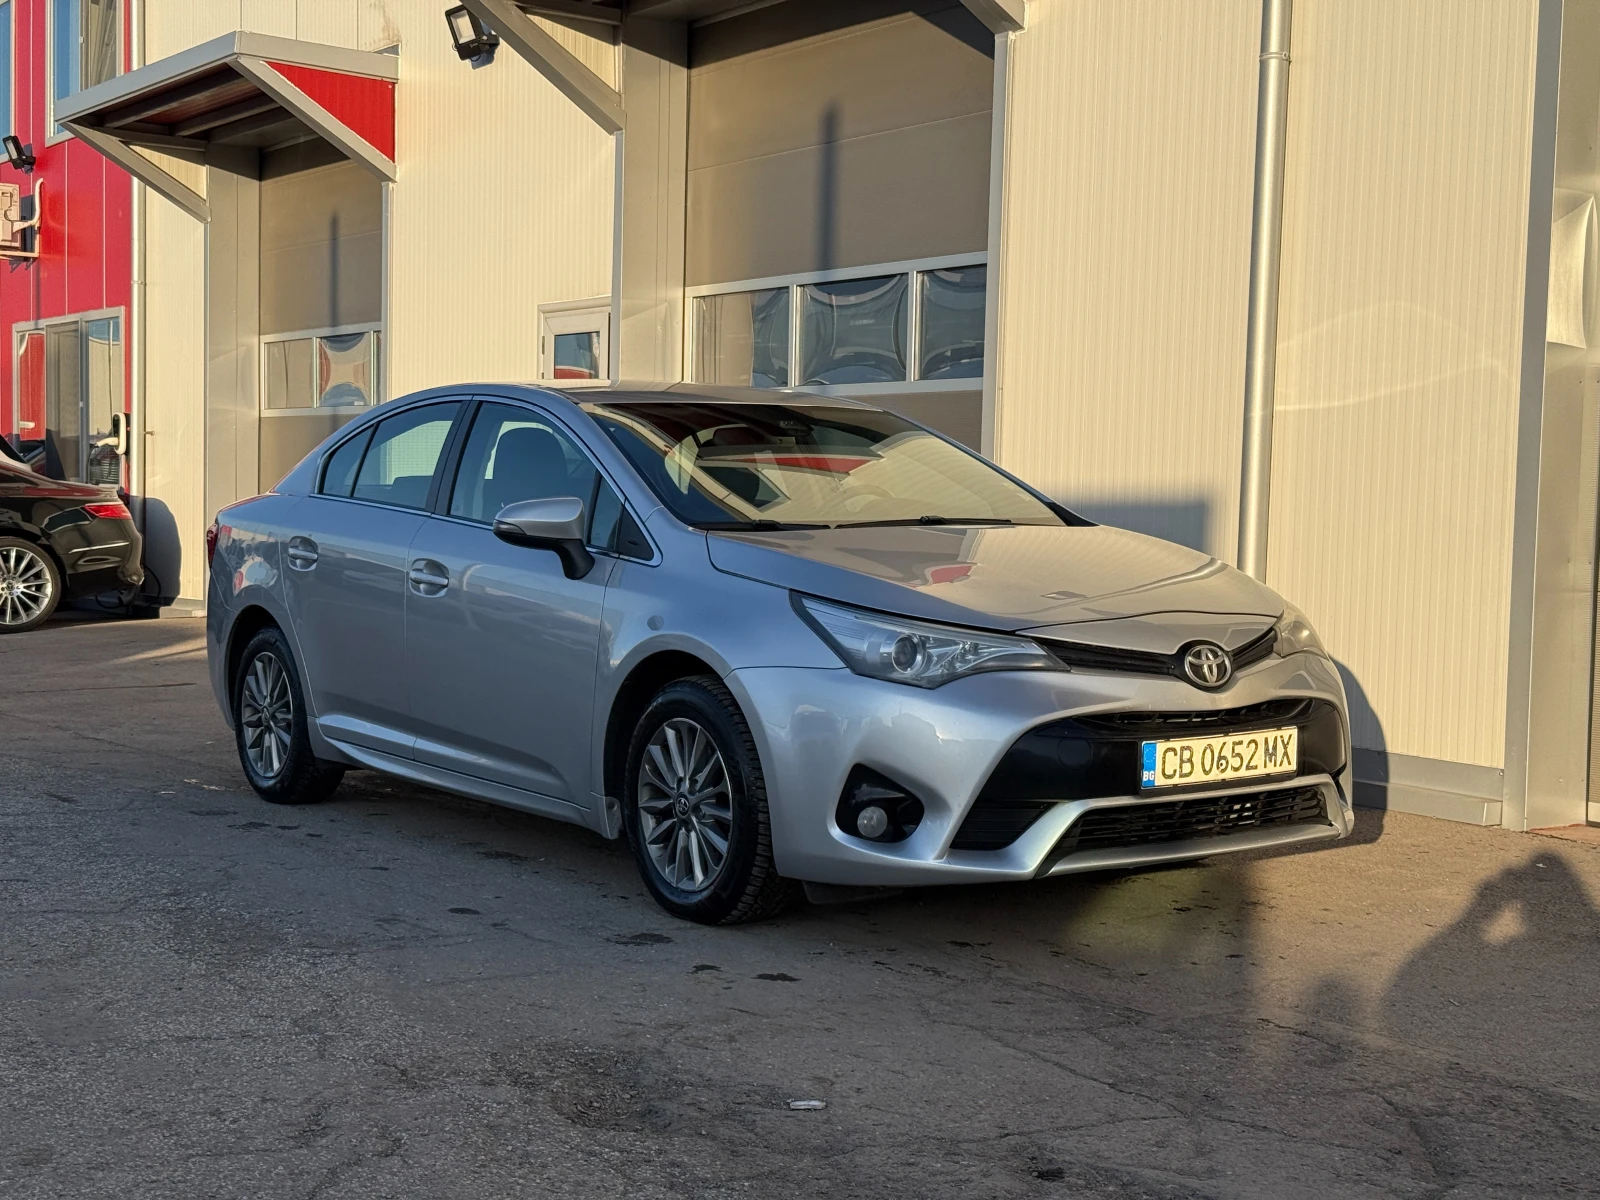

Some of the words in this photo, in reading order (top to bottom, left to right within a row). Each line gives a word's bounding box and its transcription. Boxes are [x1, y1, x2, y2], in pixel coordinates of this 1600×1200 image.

[1161, 745, 1195, 780] CB
[1200, 738, 1259, 776] 0652
[1263, 734, 1293, 769] MX
[1143, 770, 1155, 781] BG
